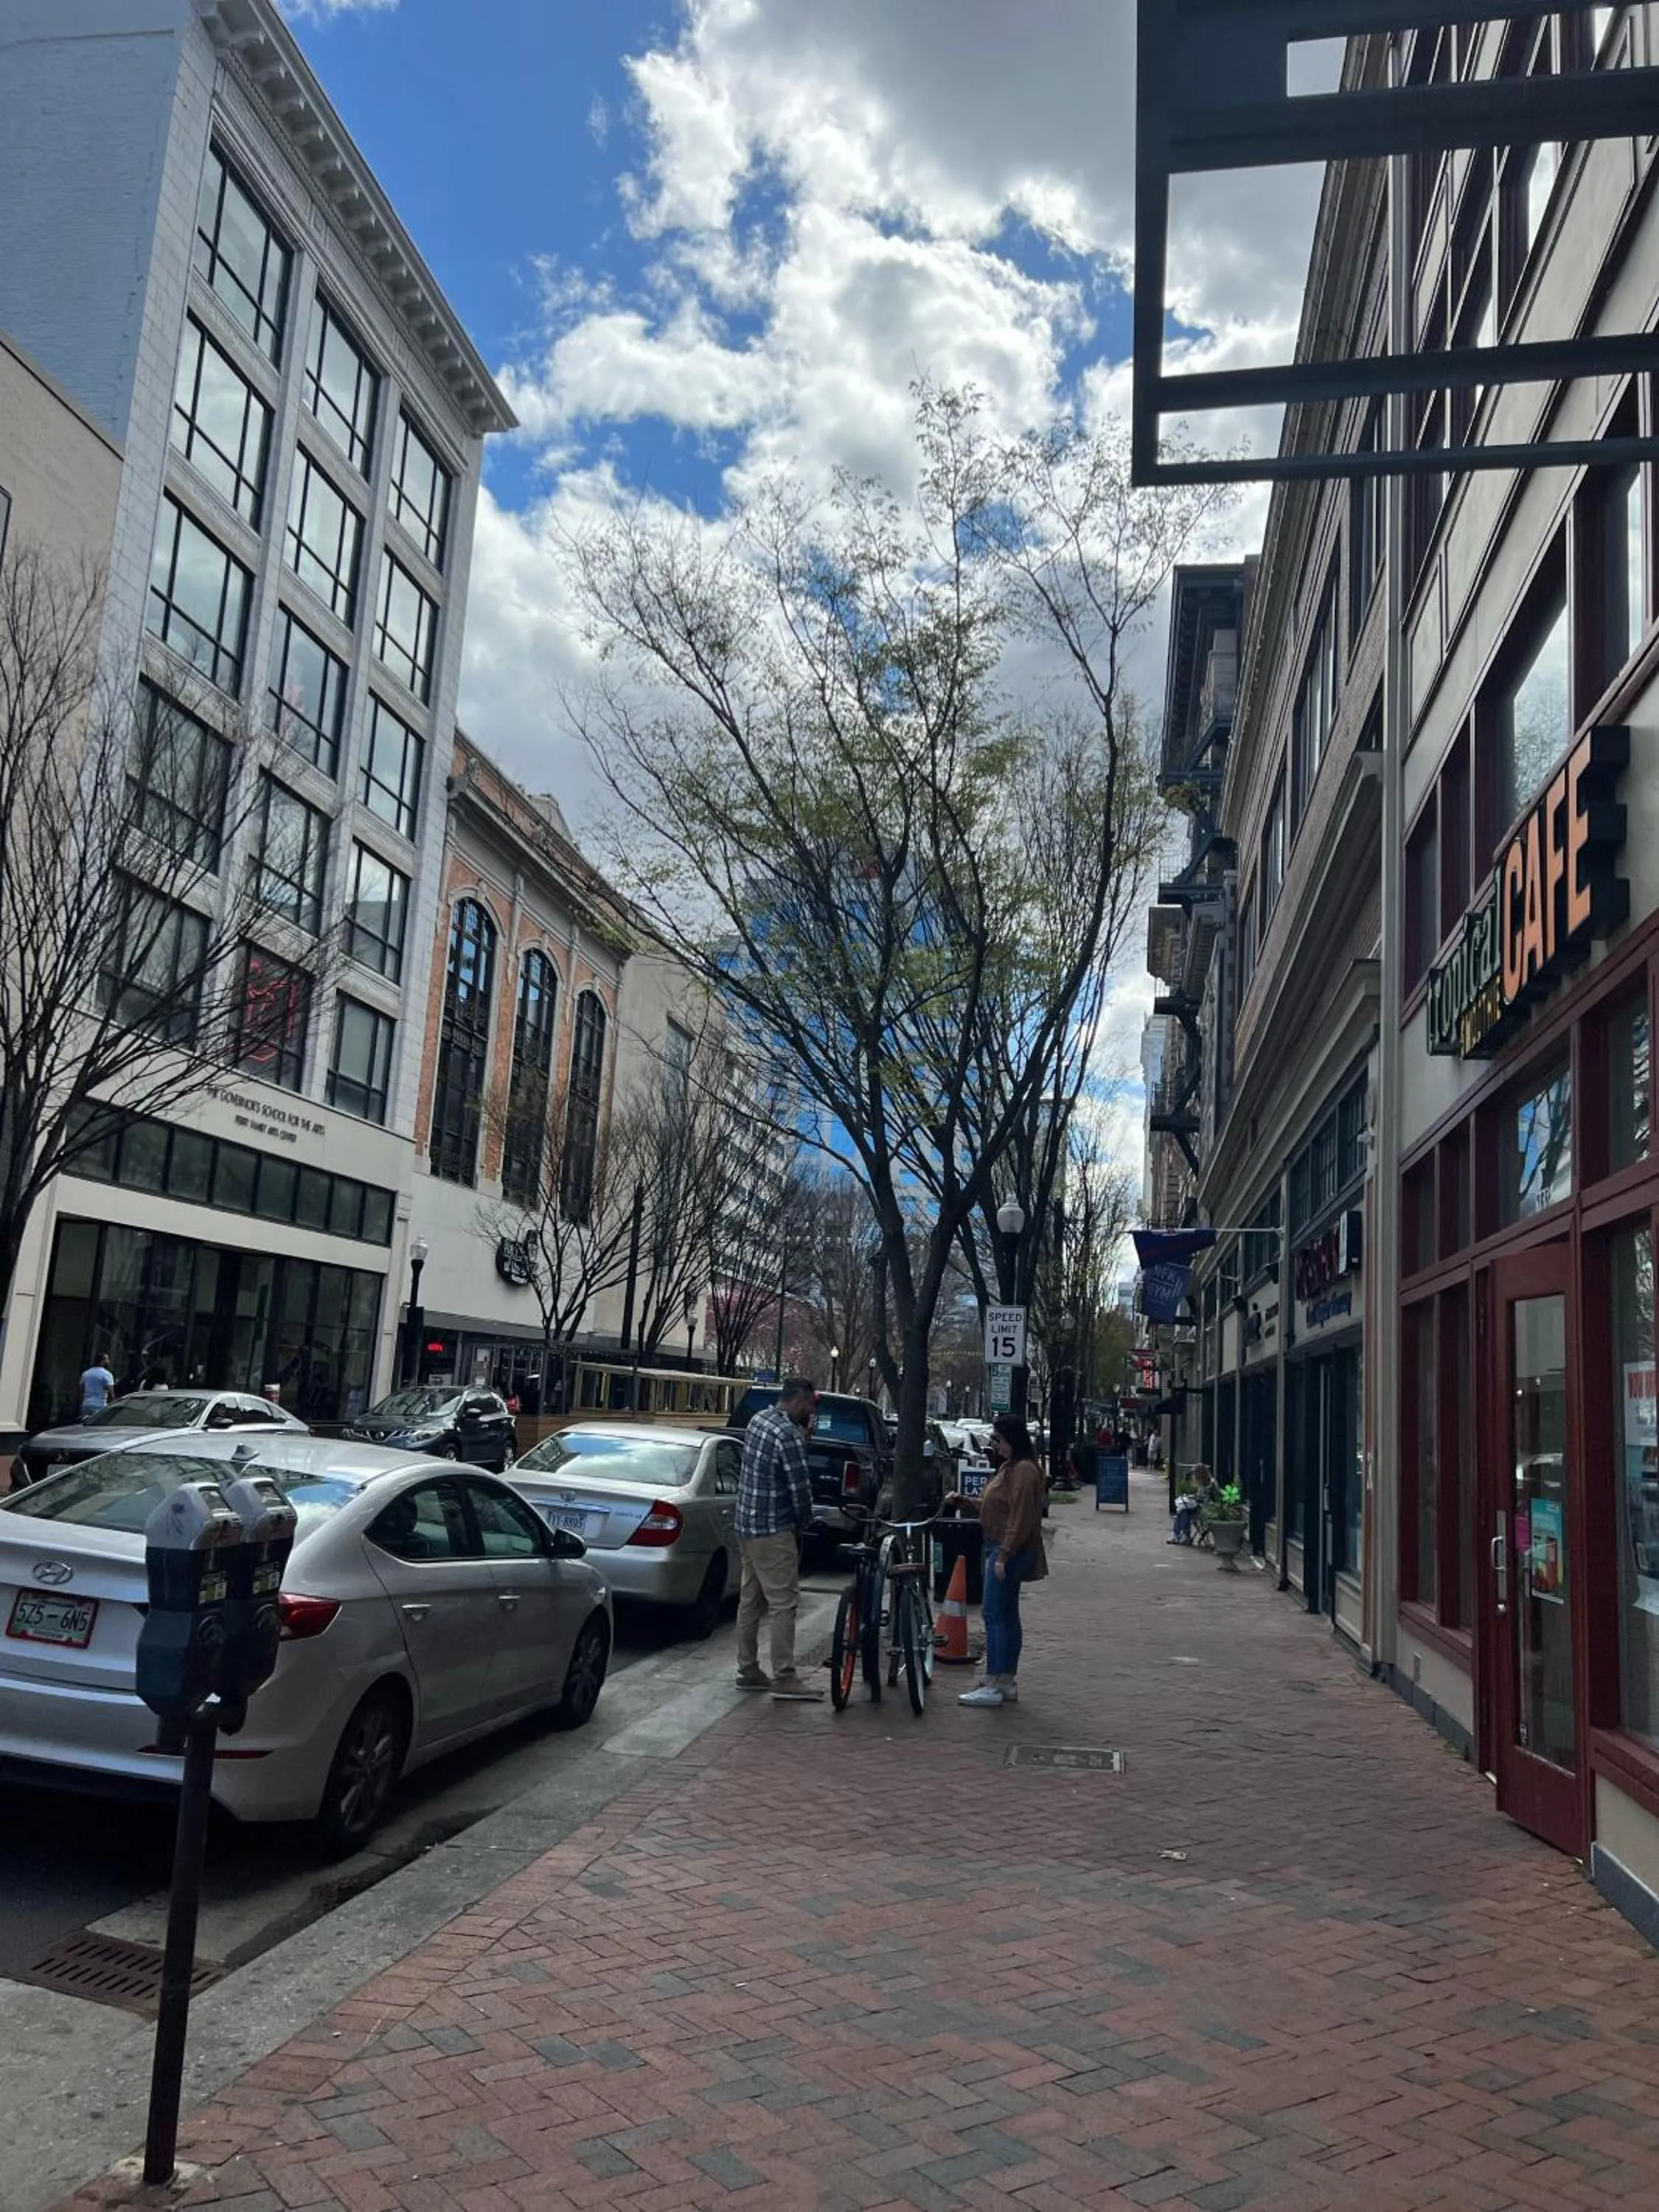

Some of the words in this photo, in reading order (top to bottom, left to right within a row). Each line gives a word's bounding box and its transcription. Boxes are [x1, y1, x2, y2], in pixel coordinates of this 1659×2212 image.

[1503, 729, 1591, 1005] CAFE
[988, 1312, 1022, 1322] SPEED
[991, 1325, 1018, 1334] LIMIT
[992, 1336, 1015, 1357] 15
